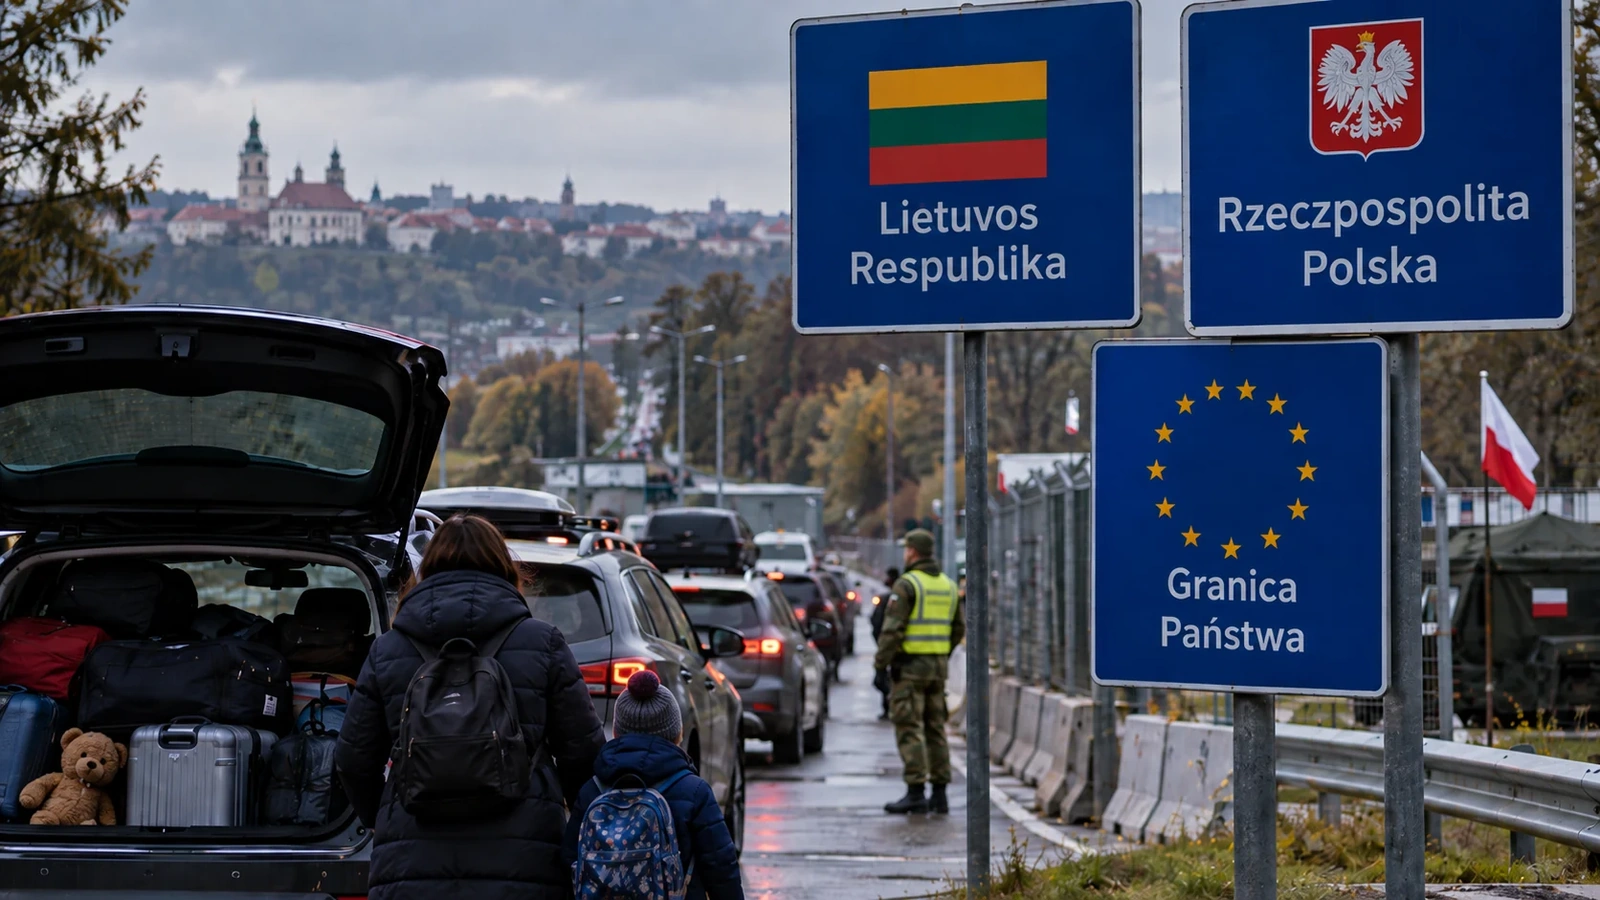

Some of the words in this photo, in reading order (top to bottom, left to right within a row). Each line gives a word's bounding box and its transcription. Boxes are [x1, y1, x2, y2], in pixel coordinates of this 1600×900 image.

[880, 199, 1038, 235] Lietuvos
[1219, 183, 1529, 238] Rzeczpospolita
[851, 244, 1066, 291] Respublika
[1304, 246, 1437, 287] Polska
[1167, 567, 1297, 602] Granica
[1161, 615, 1305, 653] Państwa
